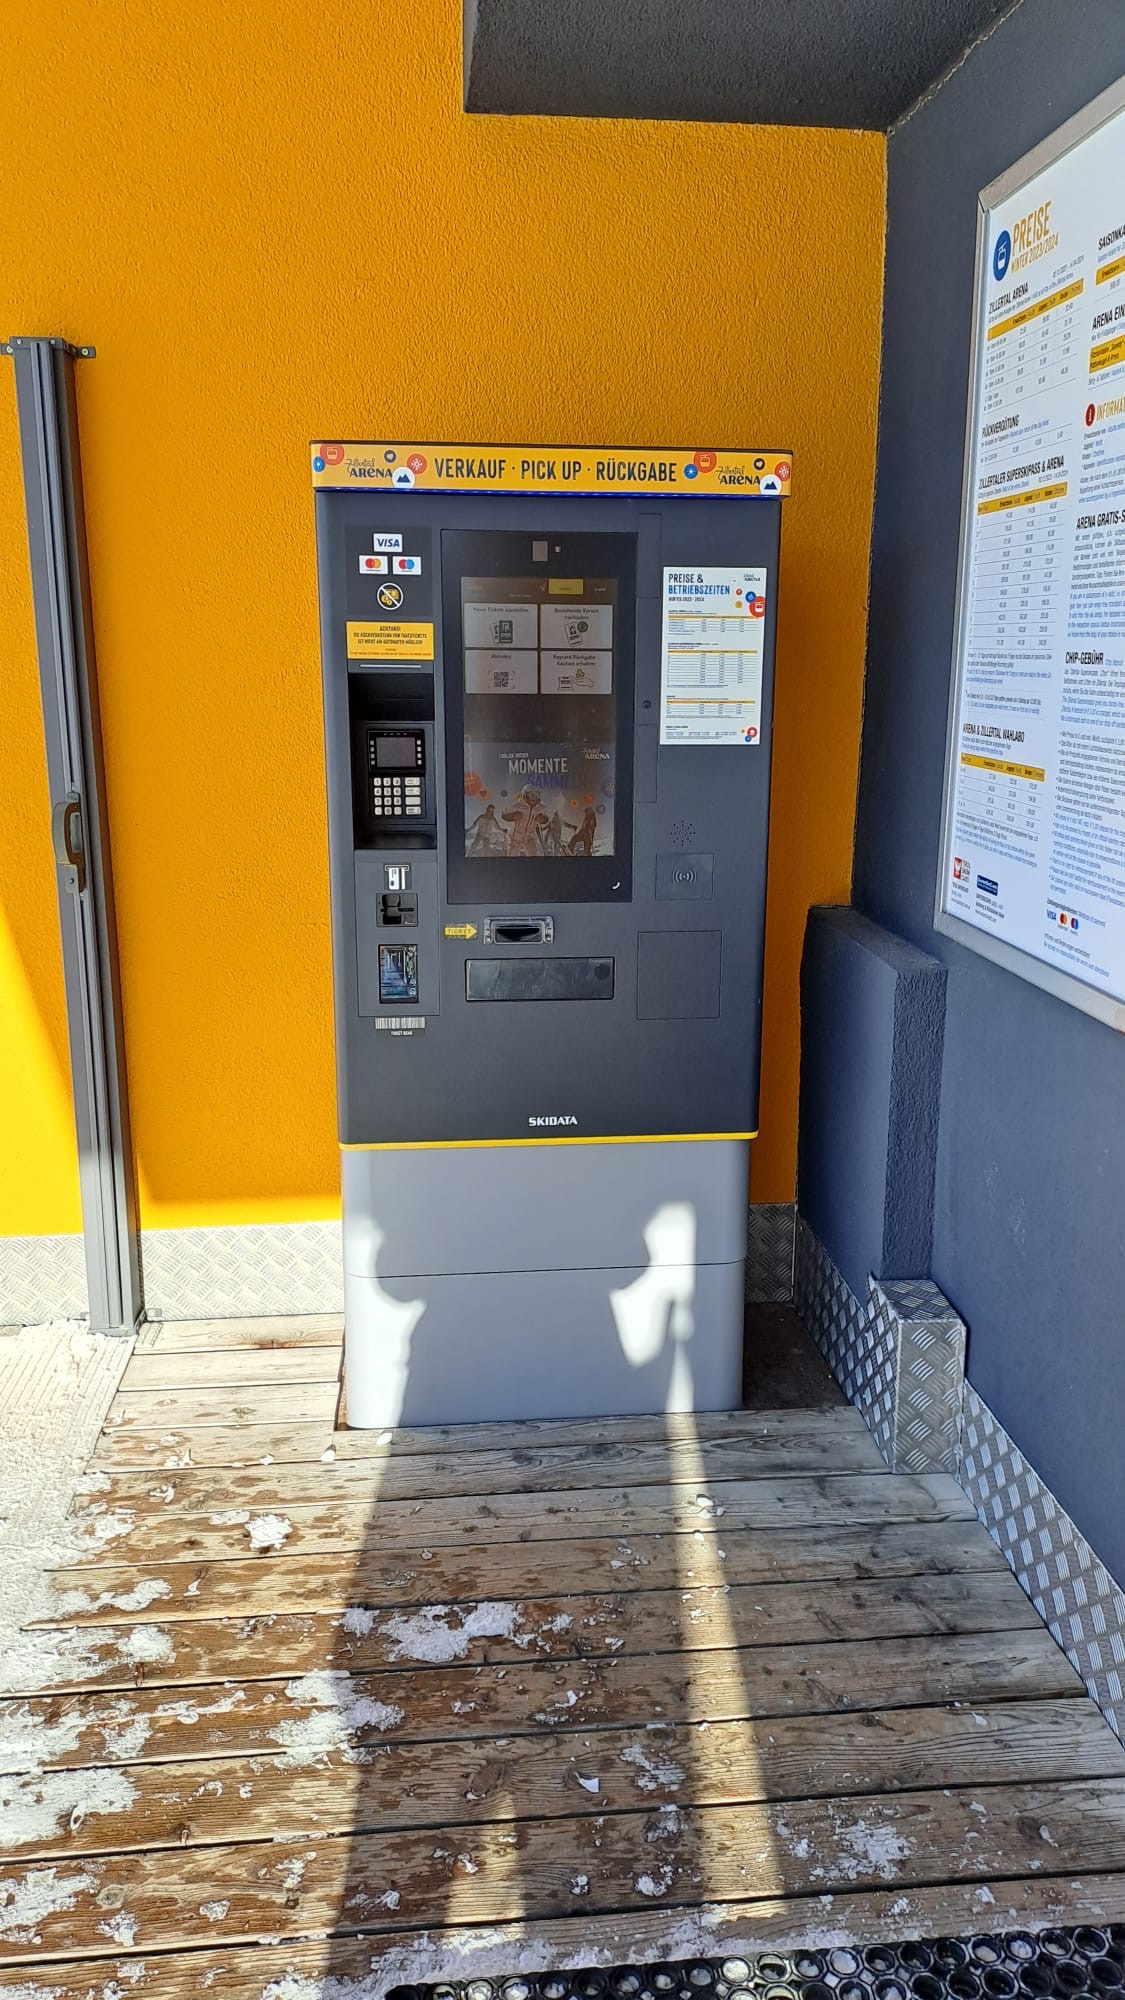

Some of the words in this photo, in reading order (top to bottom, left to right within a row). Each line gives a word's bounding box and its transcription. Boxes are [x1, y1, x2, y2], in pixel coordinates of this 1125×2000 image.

[1012, 200, 1051, 256] PREISE
[1011, 248, 1029, 274] WINTER
[1029, 232, 1059, 264] 2023/2024
[989, 289, 1012, 315] ZILLERTAL
[1012, 281, 1029, 301] ARENA
[1092, 309, 1113, 331] ARENA
[981, 414, 1020, 438] RÜCKVERGÜTUNG
[349, 467, 393, 479] ARENA
[434, 457, 507, 479] VERKAUF
[521, 460, 557, 480] PICK
[562, 461, 582, 481] UP
[596, 457, 677, 483] RÜCKGABE
[978, 469, 1006, 490] ZILLERTALER
[1006, 461, 1041, 485] SUPERSKIPASS
[1047, 455, 1065, 471] ARENA
[720, 474, 761, 486] ARENA
[1076, 515, 1096, 530] ARENA
[376, 538, 400, 547] VISA
[668, 573, 695, 584] PREISE
[696, 573, 704, 584] &
[668, 584, 731, 595] BETRIEBSZEITEN
[1065, 649, 1104, 665] CHIP-GEBÜHR
[962, 722, 977, 735] ARENA
[508, 757, 568, 774] MOMENTE
[528, 1116, 578, 1127] SKIDATA
